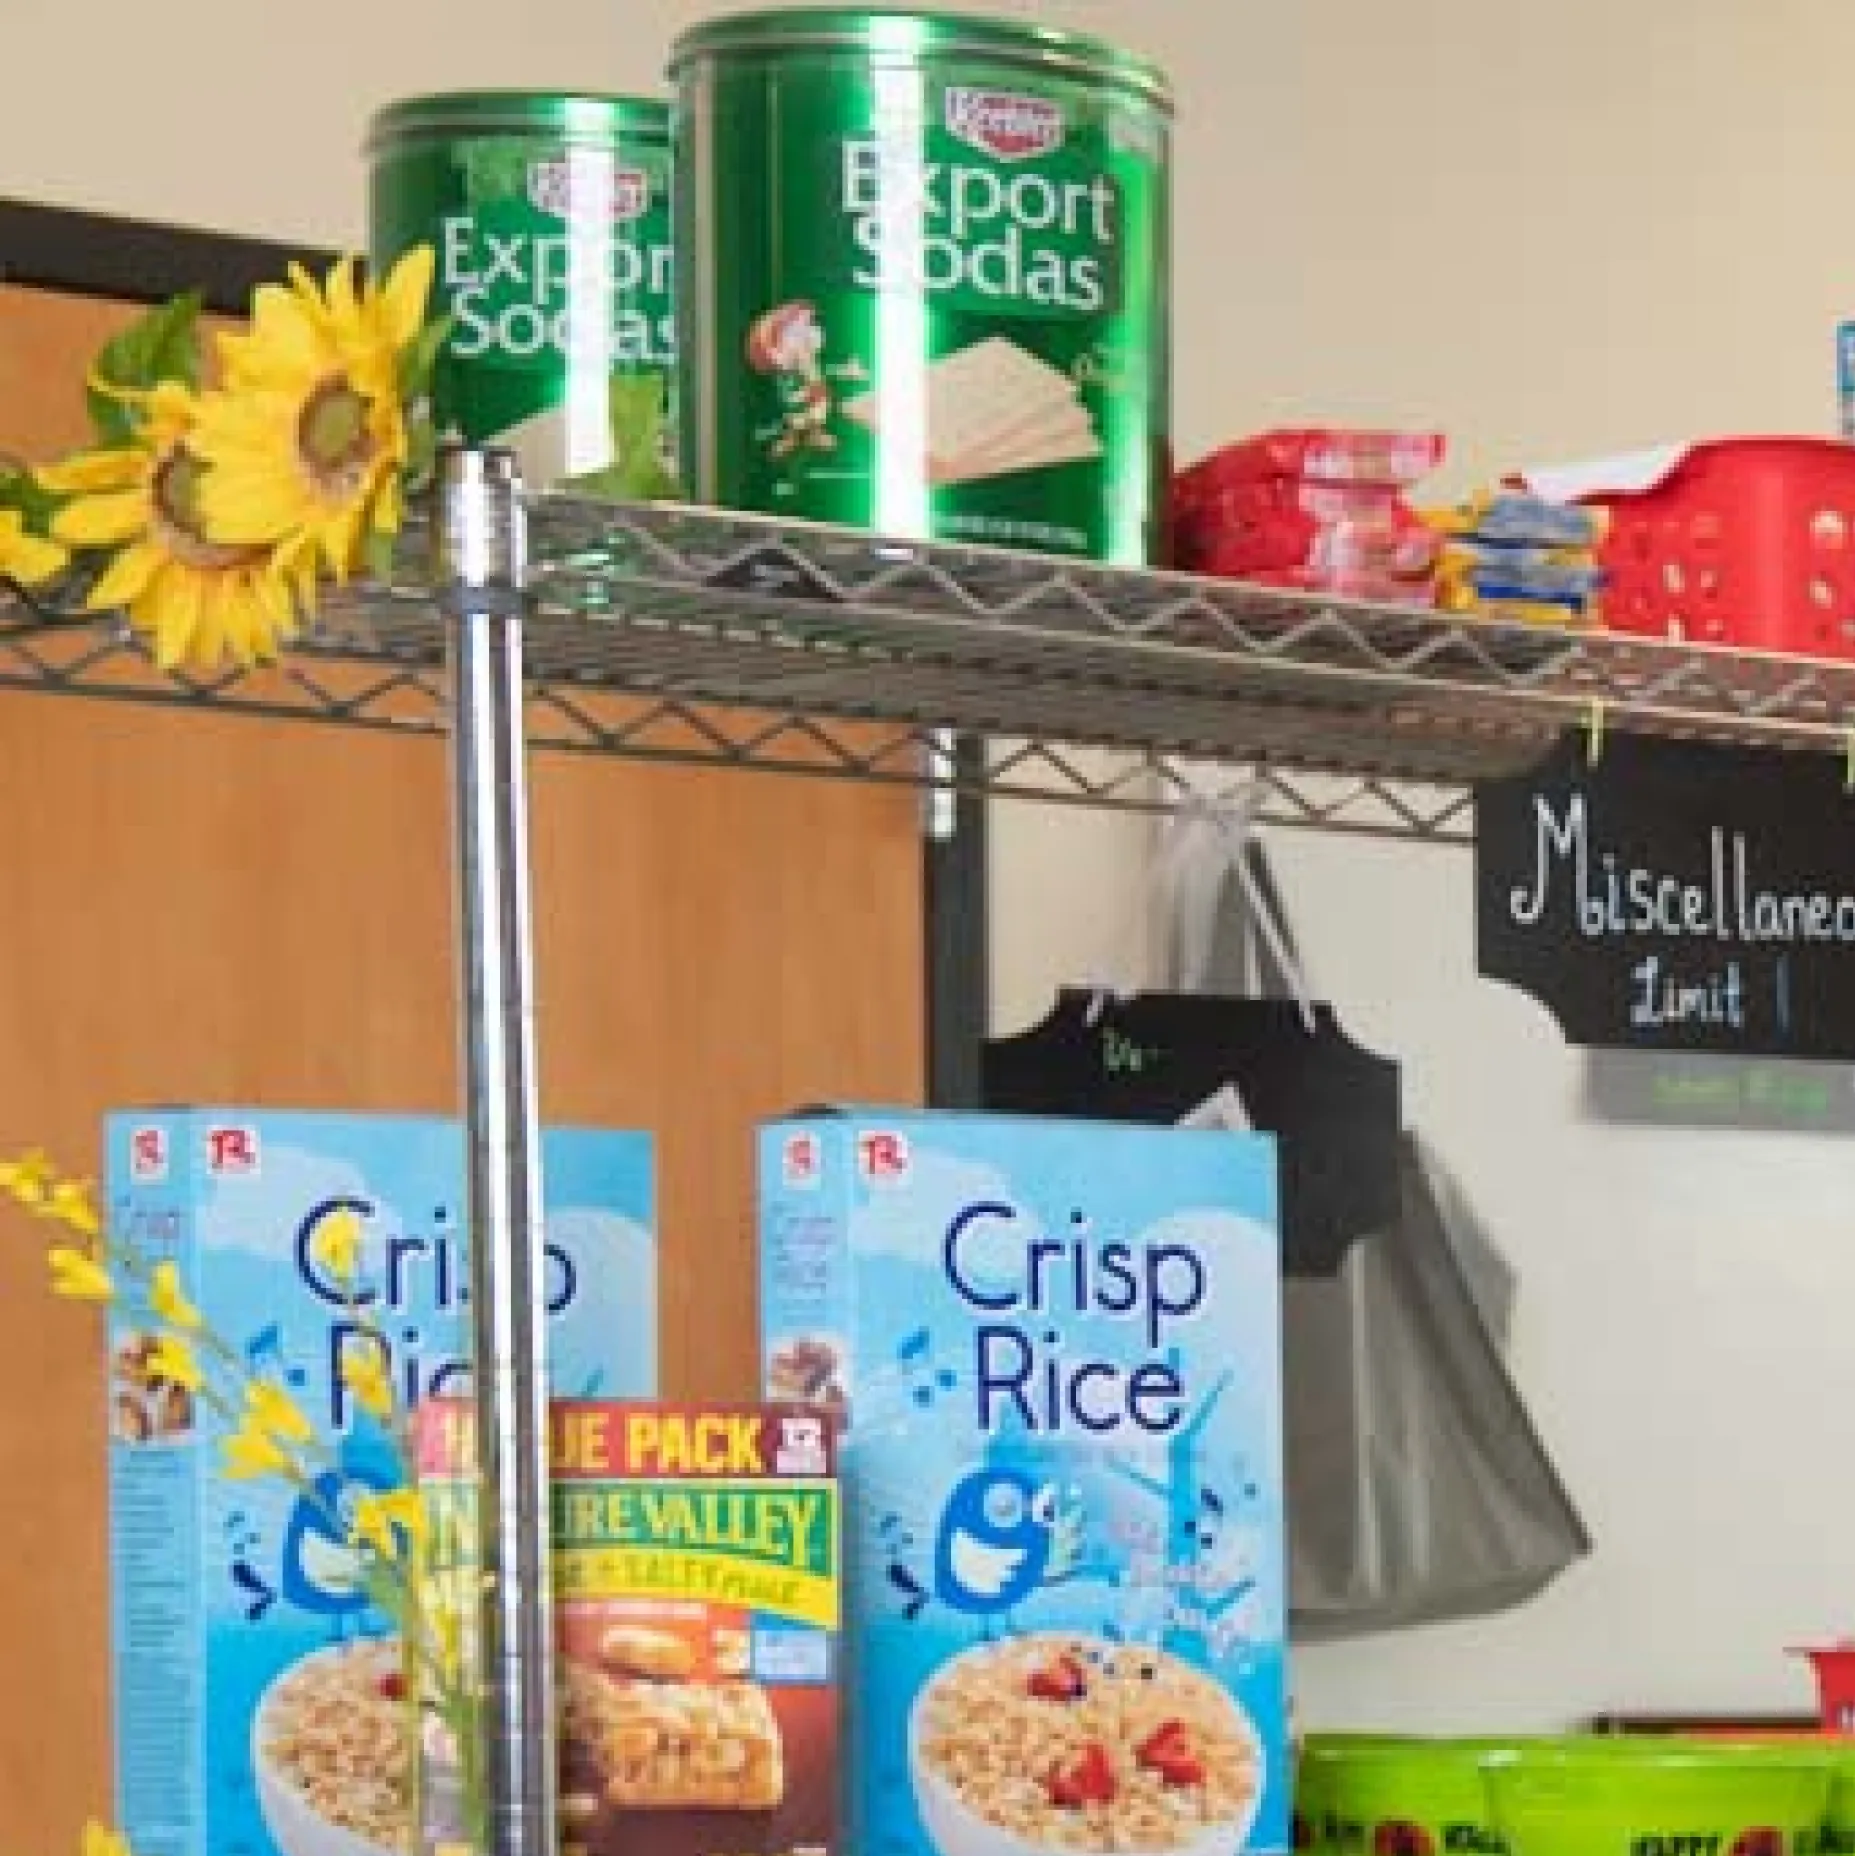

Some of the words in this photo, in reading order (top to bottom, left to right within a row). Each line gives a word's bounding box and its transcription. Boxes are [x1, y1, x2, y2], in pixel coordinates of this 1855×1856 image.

[842, 141, 1116, 245] Export
[443, 219, 672, 297] Expor
[851, 214, 1104, 310] Sodas
[450, 283, 675, 366] Soas
[293, 1197, 577, 1313] Crip
[943, 1199, 1206, 1350] Crisp
[974, 1324, 1186, 1434] Rice
[624, 1412, 763, 1471] PACK
[640, 1493, 822, 1568] VALLEY
